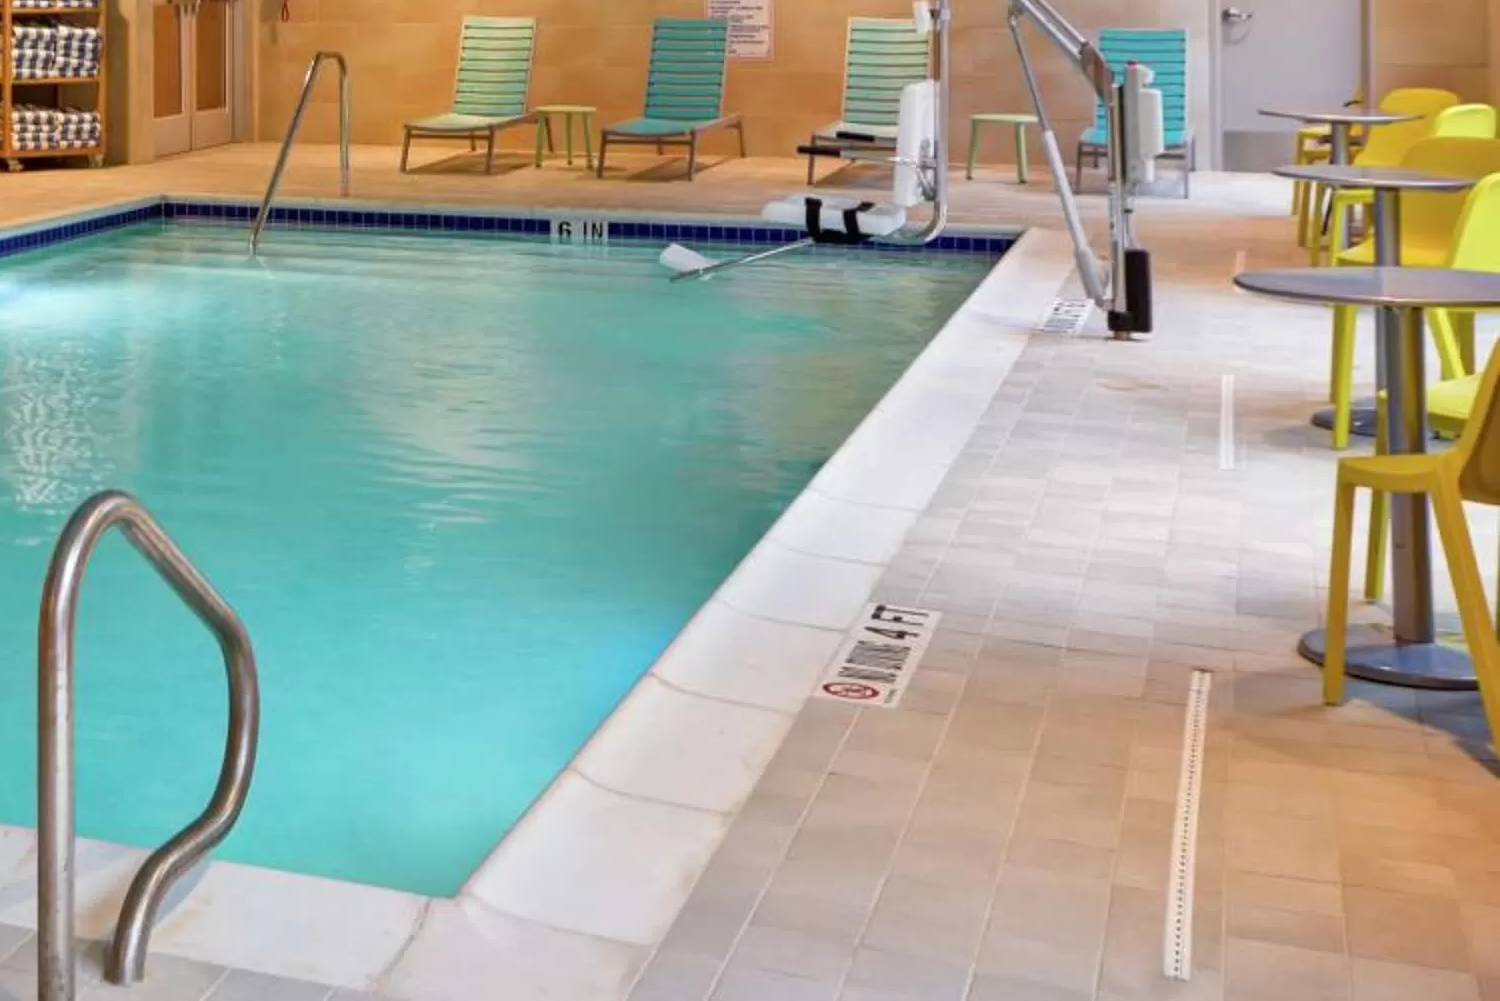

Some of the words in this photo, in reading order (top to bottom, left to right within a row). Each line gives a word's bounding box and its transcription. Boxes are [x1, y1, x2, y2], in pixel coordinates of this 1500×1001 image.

[583, 222, 603, 238] IN
[870, 604, 930, 627] FT
[864, 626, 920, 640] 4
